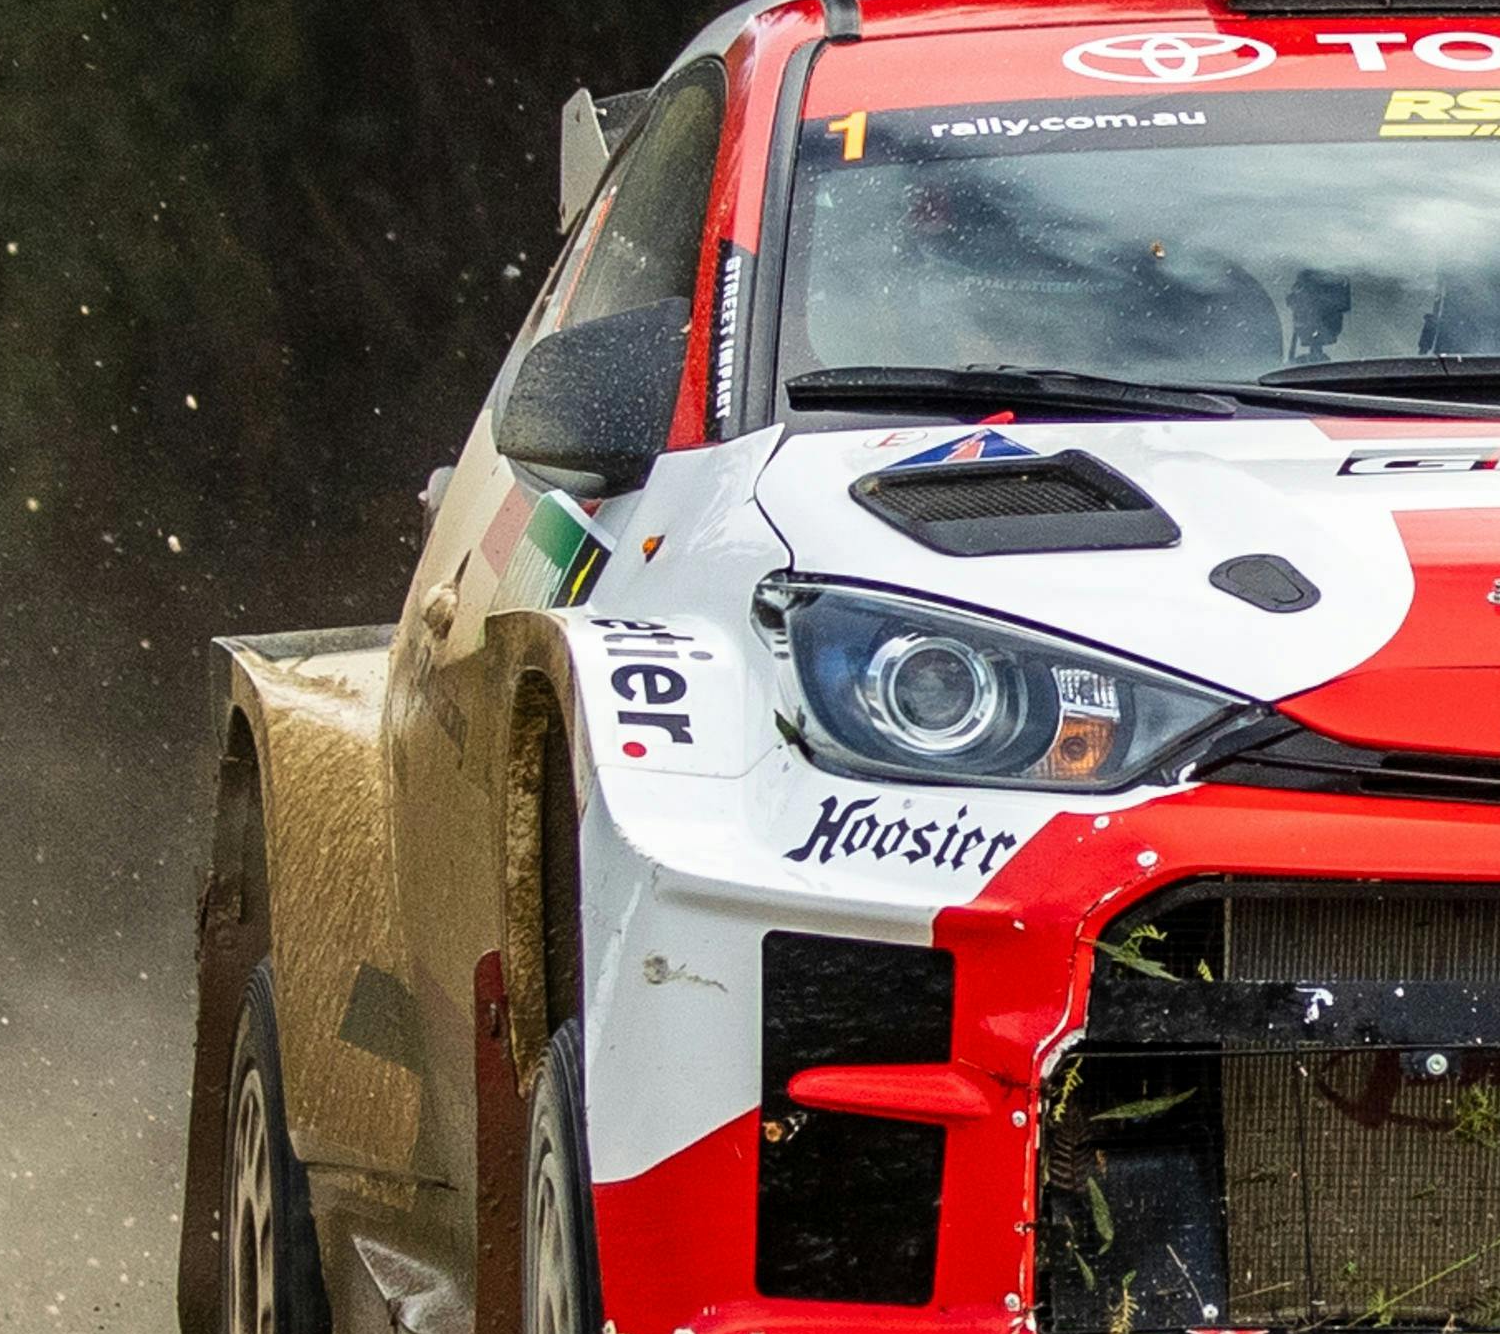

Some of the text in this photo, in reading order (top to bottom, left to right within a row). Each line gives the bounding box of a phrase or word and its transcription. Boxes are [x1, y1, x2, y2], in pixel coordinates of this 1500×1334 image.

[827, 111, 868, 162] 1
[930, 109, 1208, 138] rally.com.au
[716, 255, 742, 418] STREET IMPACT
[782, 795, 1017, 876] Hoosier
